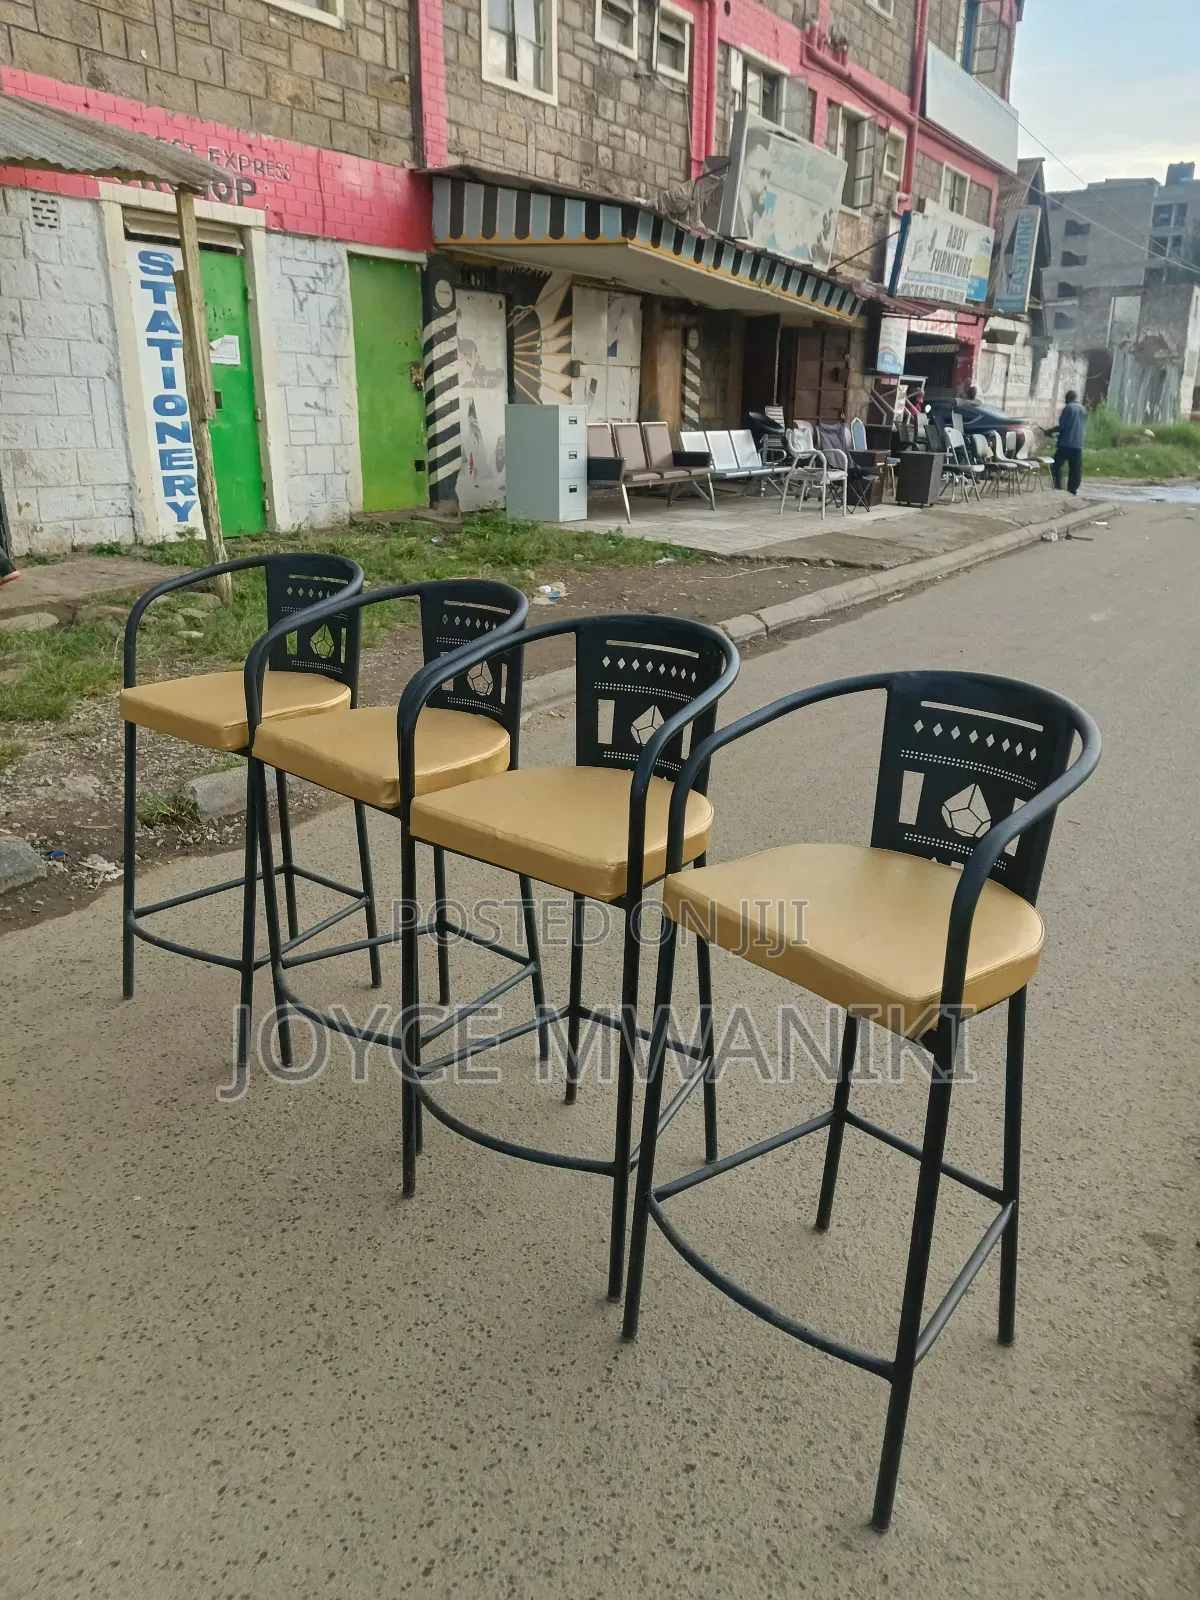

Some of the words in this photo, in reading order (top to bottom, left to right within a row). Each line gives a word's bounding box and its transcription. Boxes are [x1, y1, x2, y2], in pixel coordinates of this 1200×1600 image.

[207, 145, 292, 182] EXPRESS
[946, 225, 970, 252] ABBY
[137, 250, 197, 523] STATIONERY
